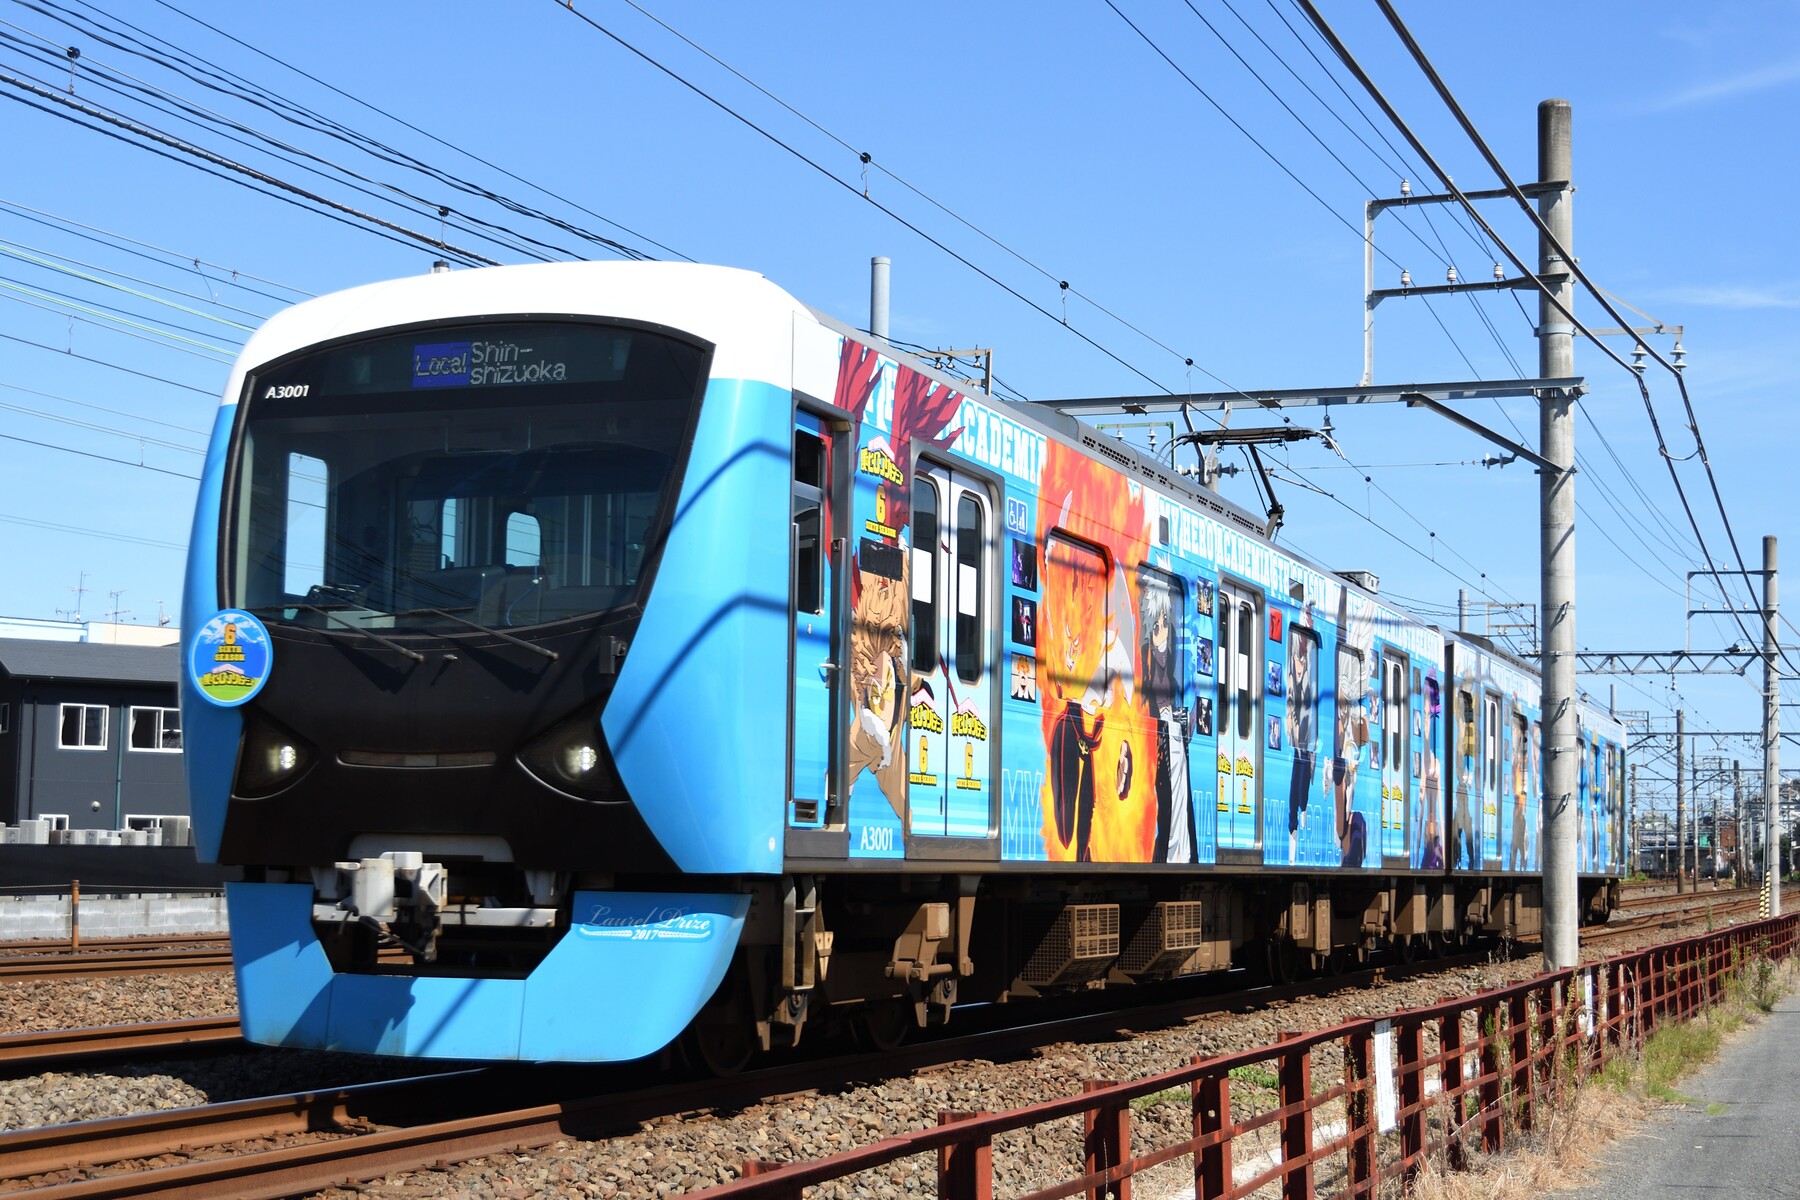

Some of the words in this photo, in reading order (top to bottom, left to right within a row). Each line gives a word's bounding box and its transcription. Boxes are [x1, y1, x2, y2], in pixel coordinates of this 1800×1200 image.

[416, 352, 468, 376] Local
[471, 342, 533, 363] Shin-
[471, 359, 567, 385] shizuoka
[265, 384, 309, 399] A3001
[225, 623, 237, 645] 6
[860, 826, 893, 850] A3001
[582, 904, 659, 928] Laurel
[654, 907, 711, 930] Prize
[631, 929, 660, 941] 2017
